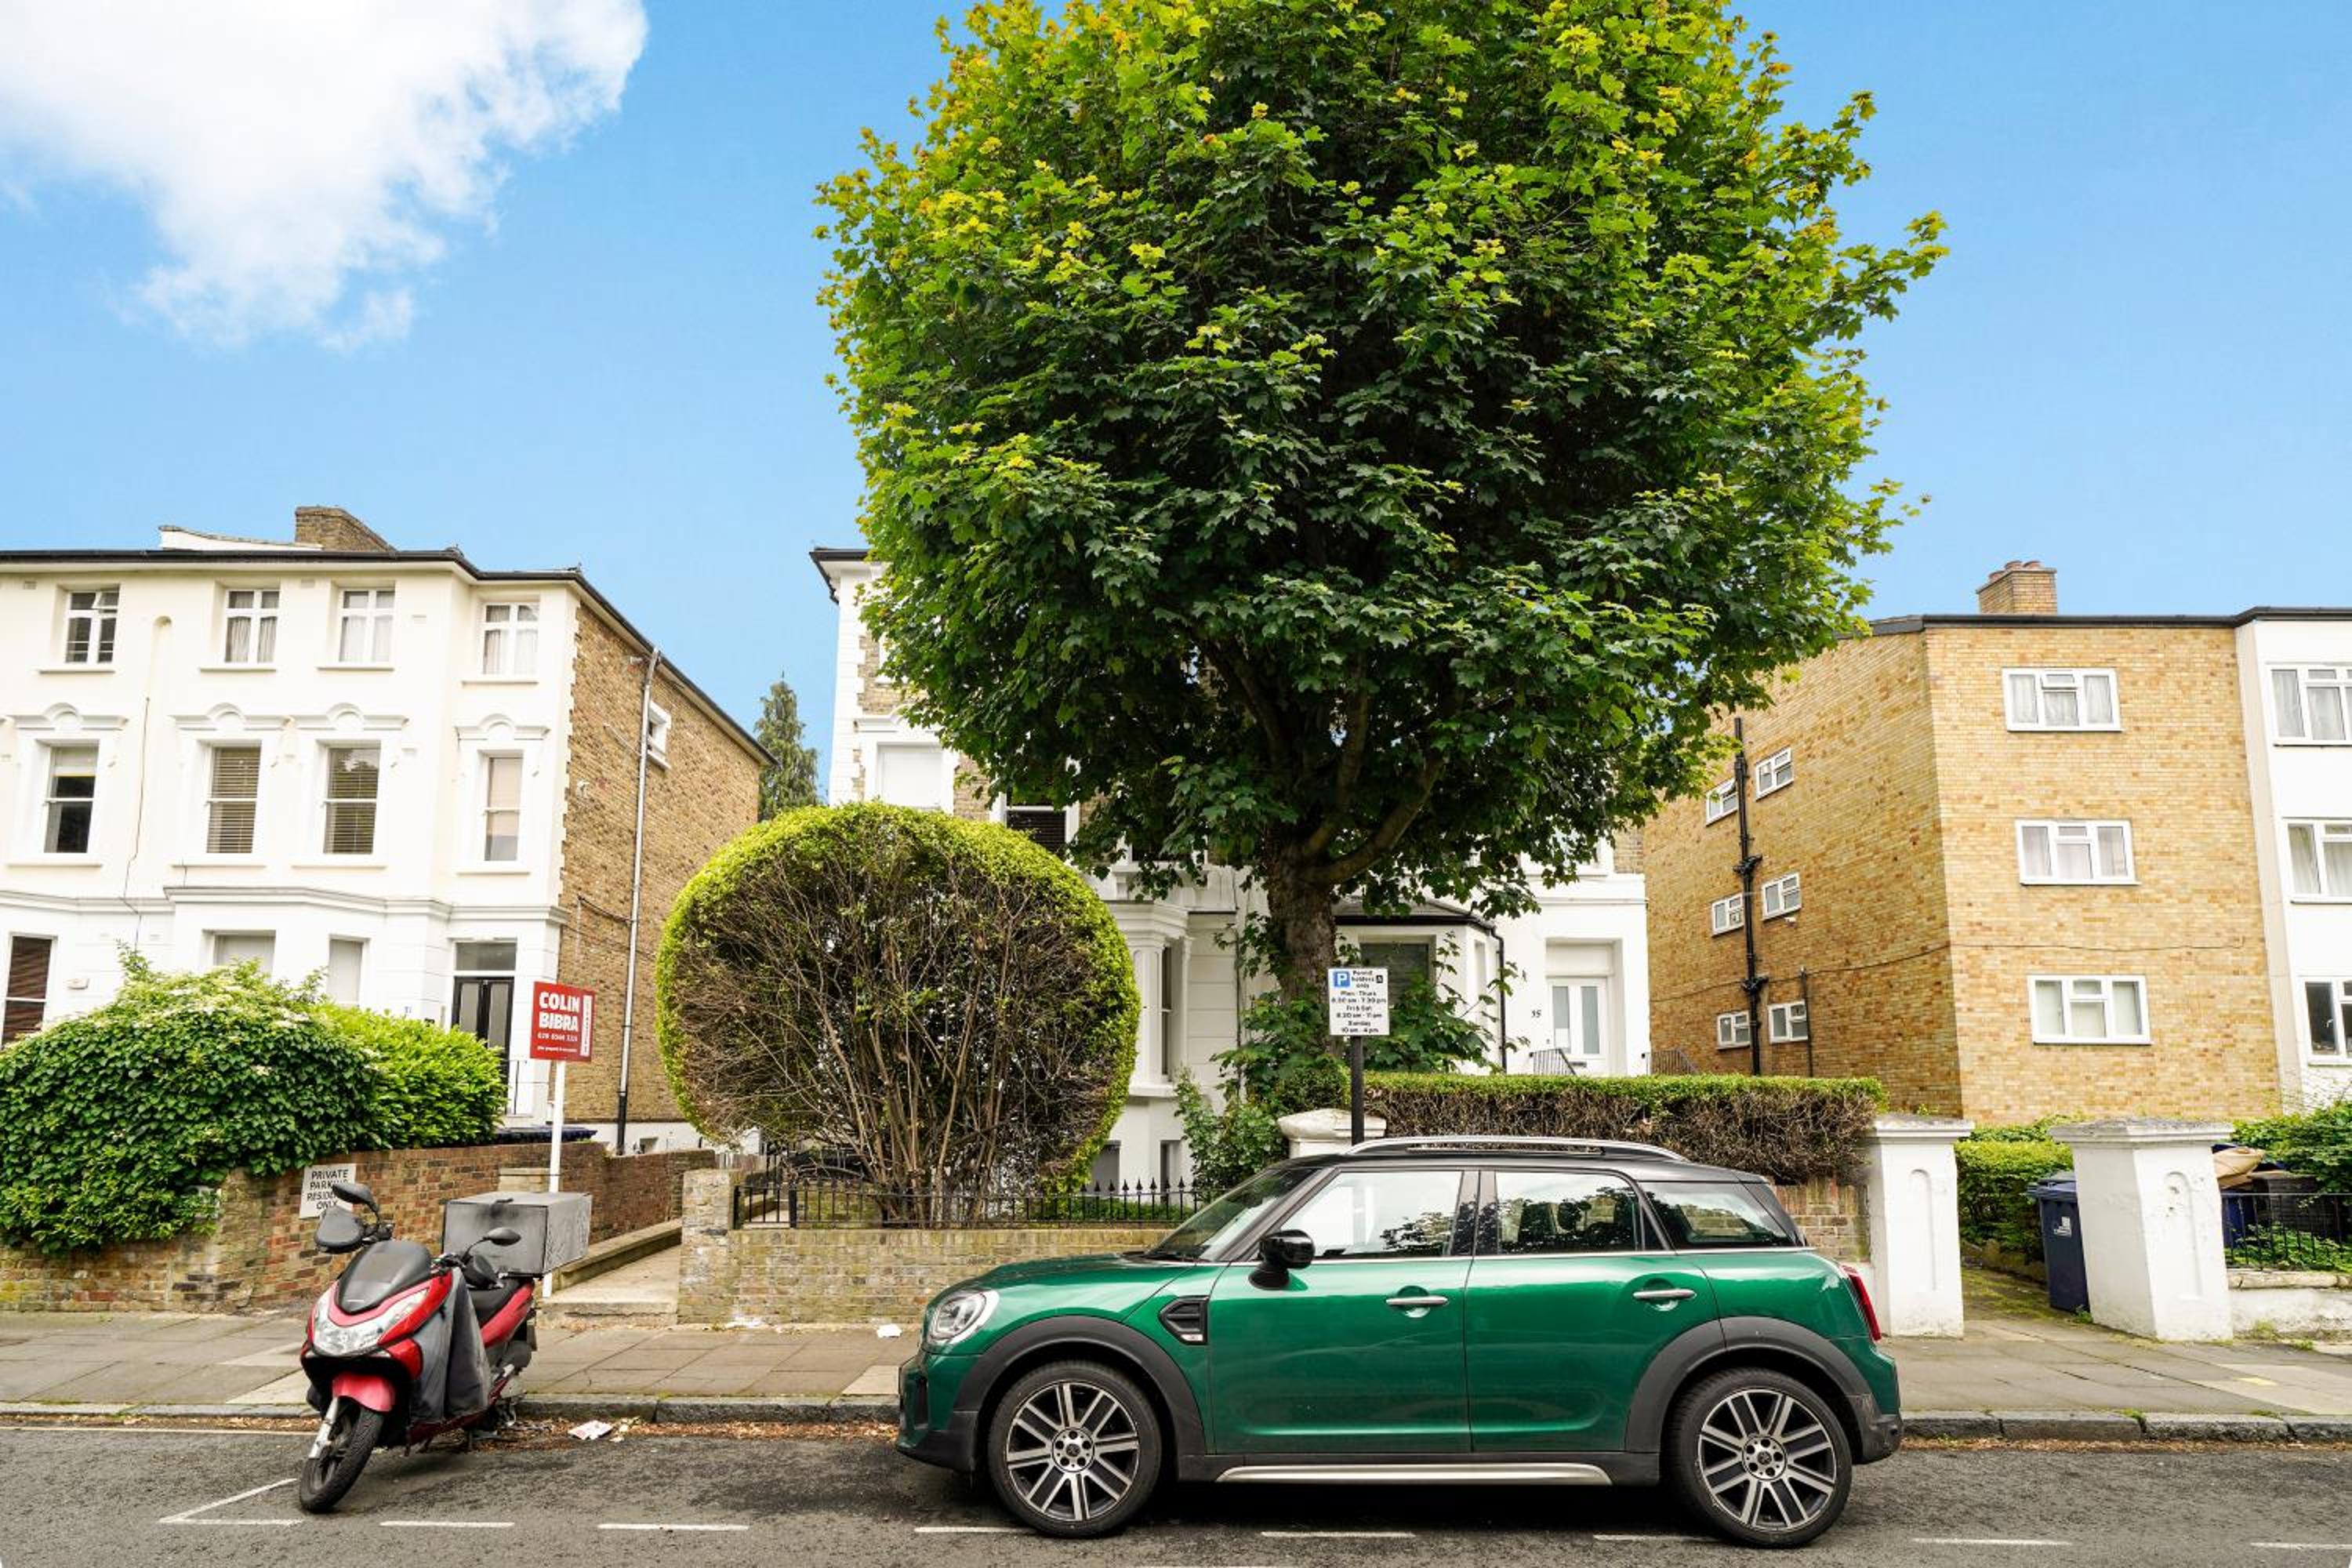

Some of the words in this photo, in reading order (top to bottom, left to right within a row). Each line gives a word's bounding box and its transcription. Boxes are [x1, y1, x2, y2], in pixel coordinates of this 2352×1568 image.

[1338, 973, 1348, 985] P
[539, 992, 579, 1013] COLIN
[539, 1011, 579, 1031] BIBRA
[311, 1169, 349, 1180] PRIVATE
[316, 1200, 338, 1210] ONLY
